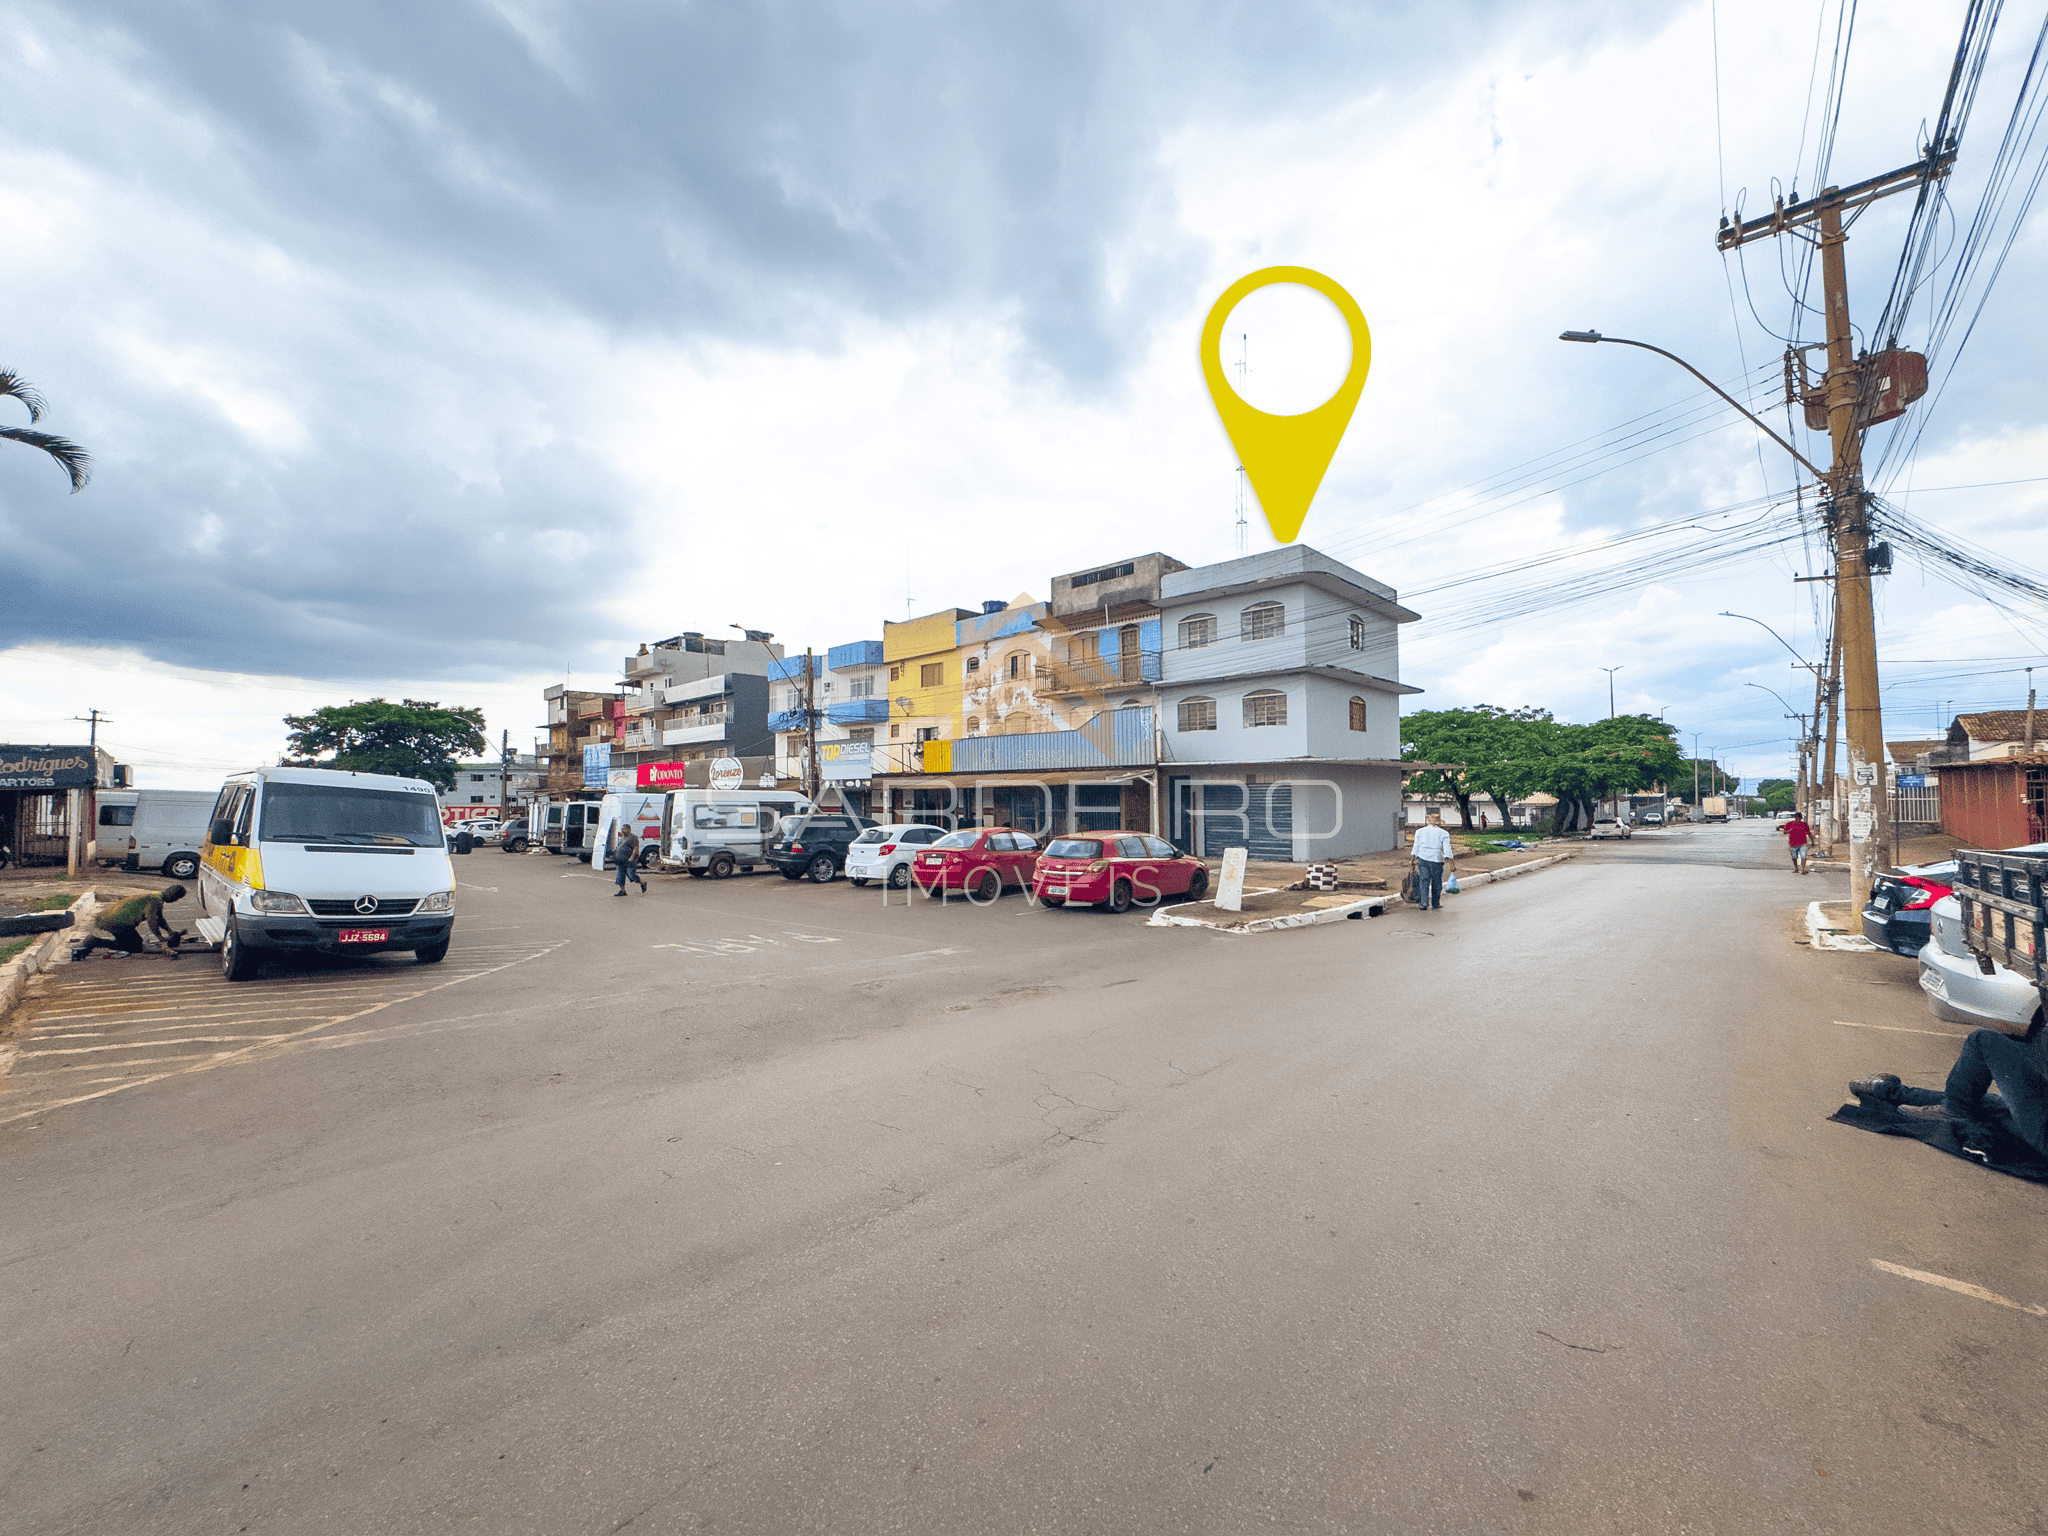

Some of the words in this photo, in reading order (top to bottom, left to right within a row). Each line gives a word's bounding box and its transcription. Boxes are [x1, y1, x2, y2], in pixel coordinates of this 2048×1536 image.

[822, 745, 840, 761] TOP
[840, 742, 870, 755] DIESEL
[0, 756, 89, 777] odrigues
